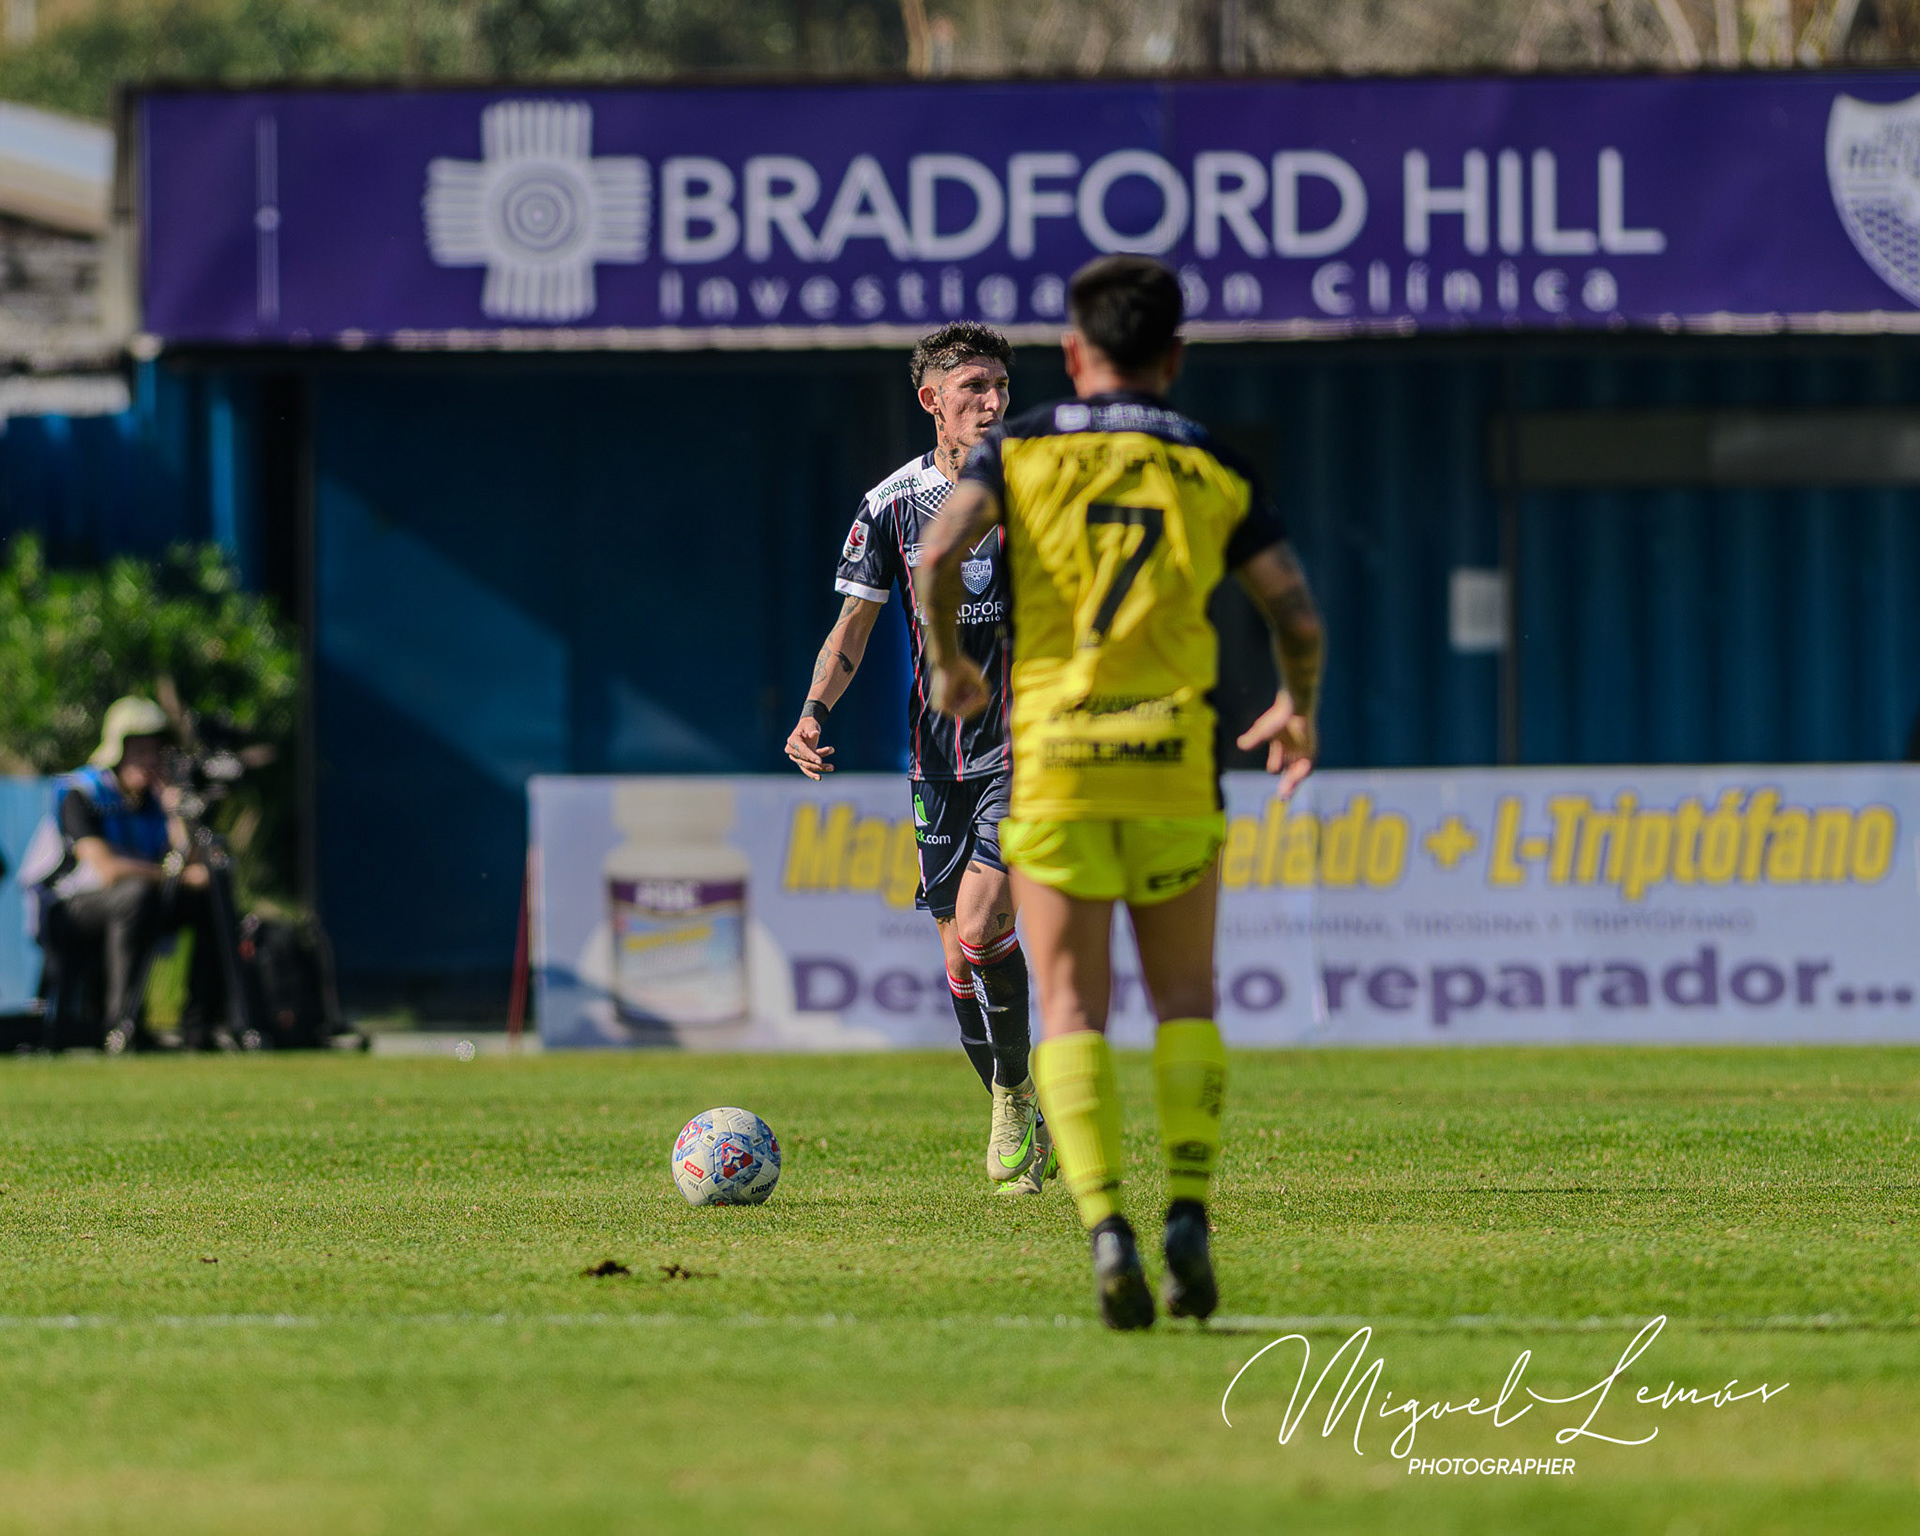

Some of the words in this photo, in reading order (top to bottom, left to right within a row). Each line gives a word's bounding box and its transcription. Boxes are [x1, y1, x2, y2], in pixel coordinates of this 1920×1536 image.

[661, 149, 1369, 263] BRADFORD
[1403, 147, 1667, 255] HILL
[658, 268, 1262, 323] Investigaón
[1311, 258, 1618, 315] Clínica
[1087, 504, 1164, 639] 7
[1488, 788, 1897, 902] L-Triptófano
[1322, 945, 1913, 1026] reparador...
